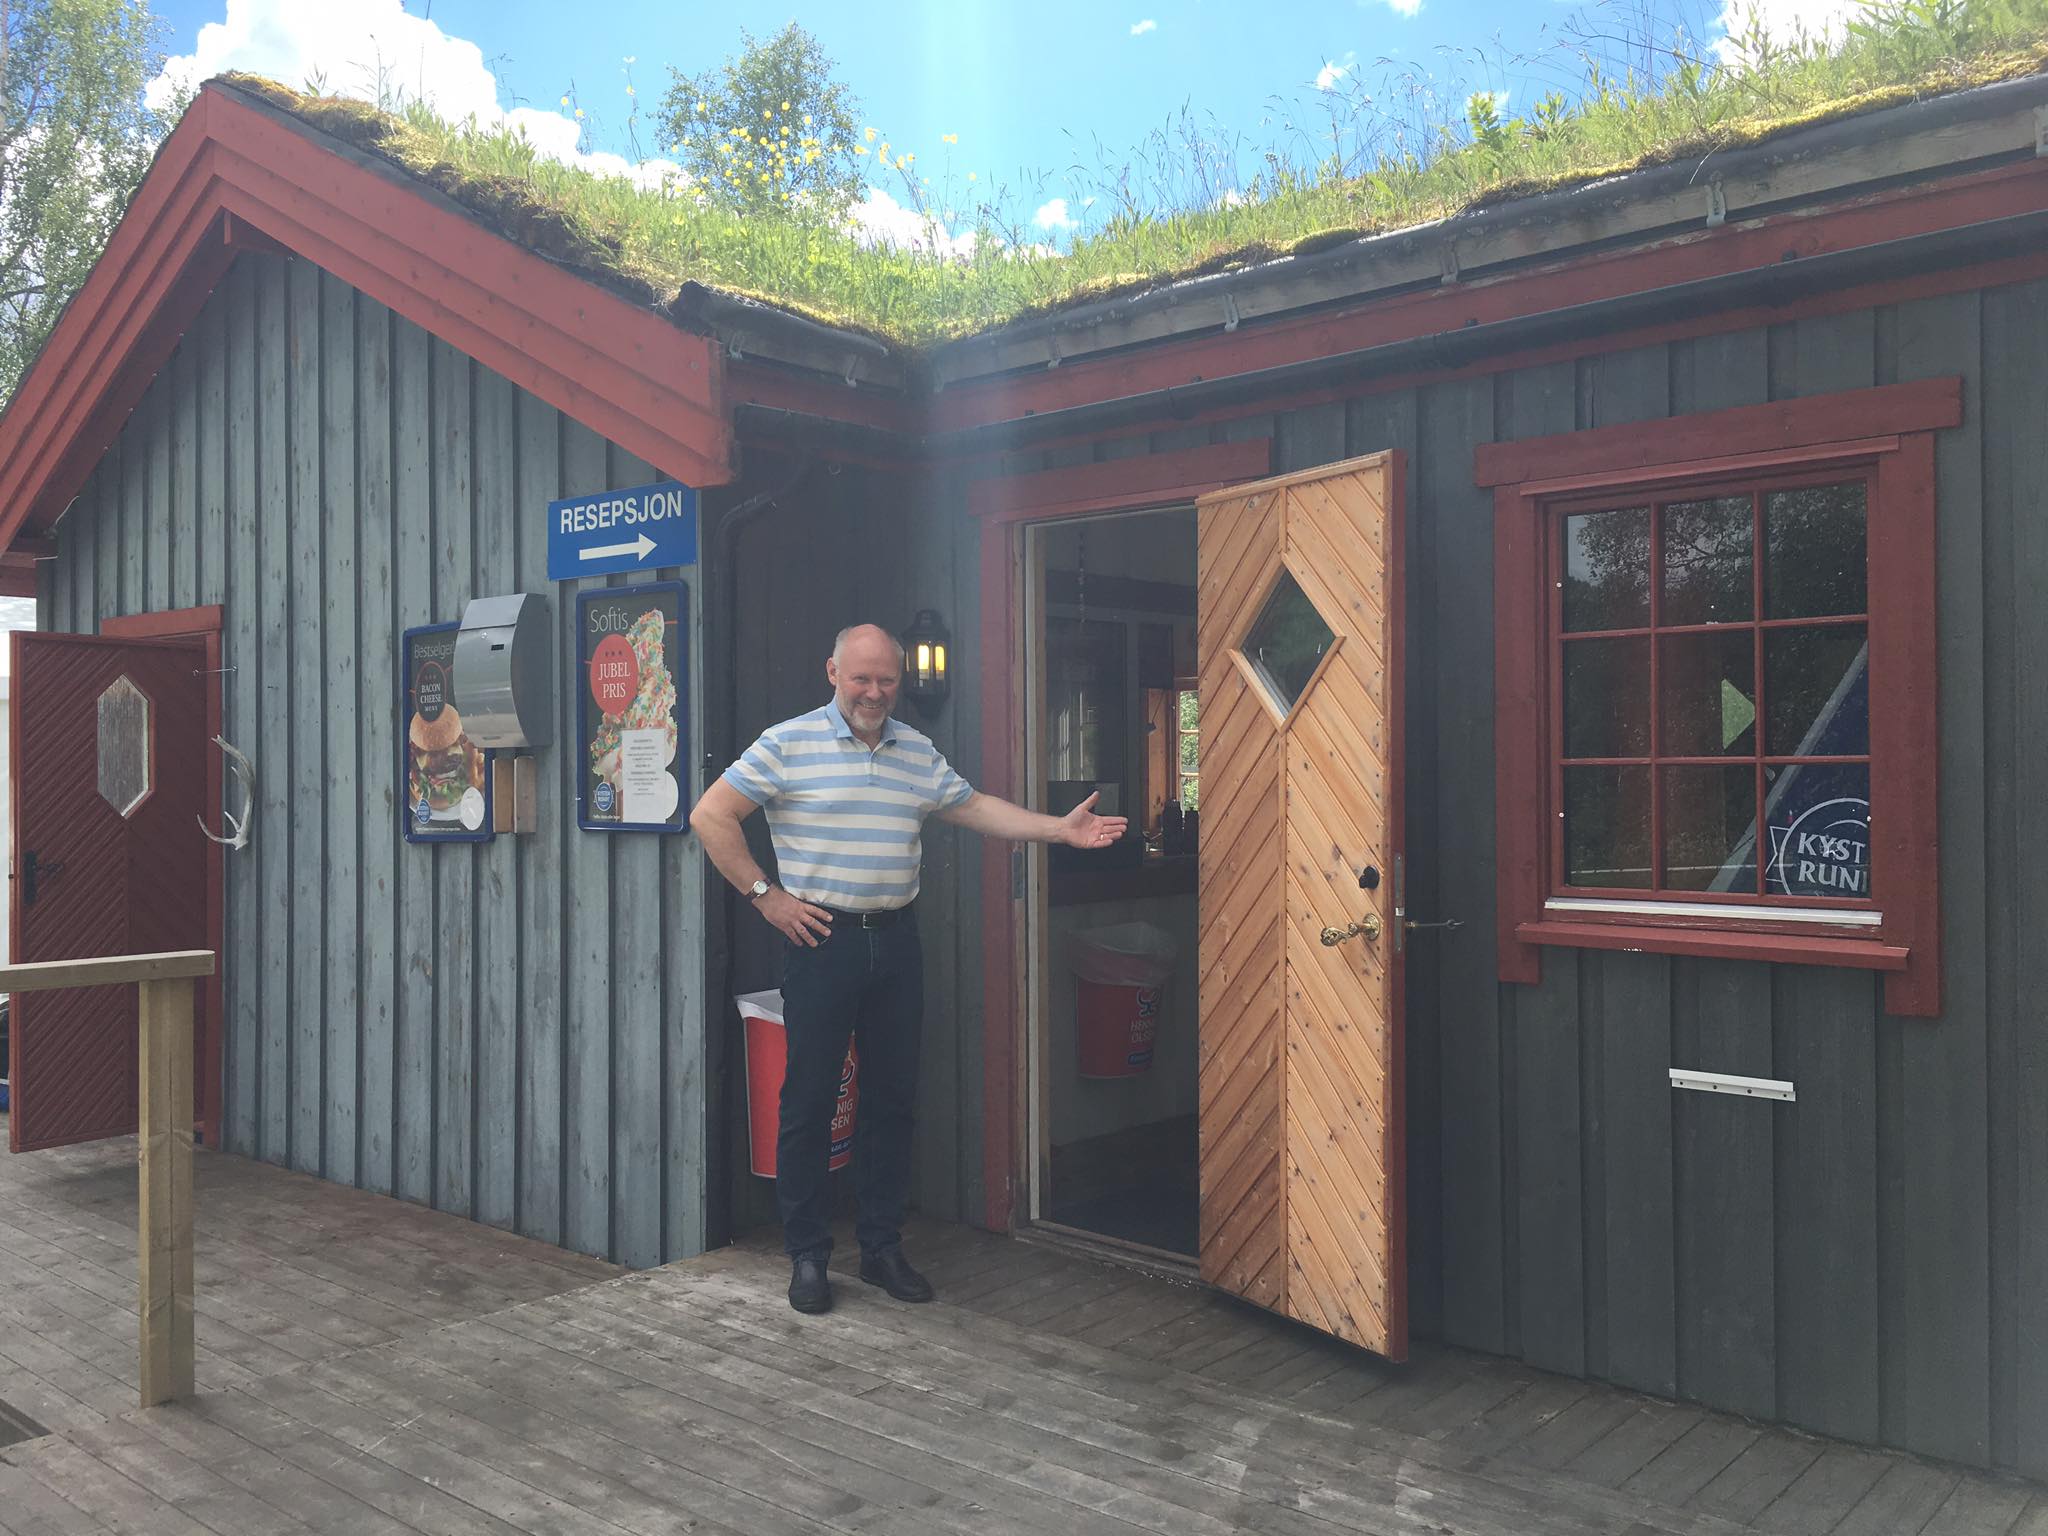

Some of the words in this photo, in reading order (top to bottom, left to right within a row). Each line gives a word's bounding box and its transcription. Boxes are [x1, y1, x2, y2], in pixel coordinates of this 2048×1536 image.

[560, 490, 682, 534] RESEPSJON
[590, 606, 629, 633] Softis
[599, 662, 630, 681] JUBEL
[421, 683, 440, 694] BACON
[603, 682, 626, 699] PRIS
[420, 693, 442, 704] CHEESE
[1797, 832, 1866, 864] KYST
[836, 1098, 854, 1115] NIG
[831, 1114, 850, 1131] SEN
